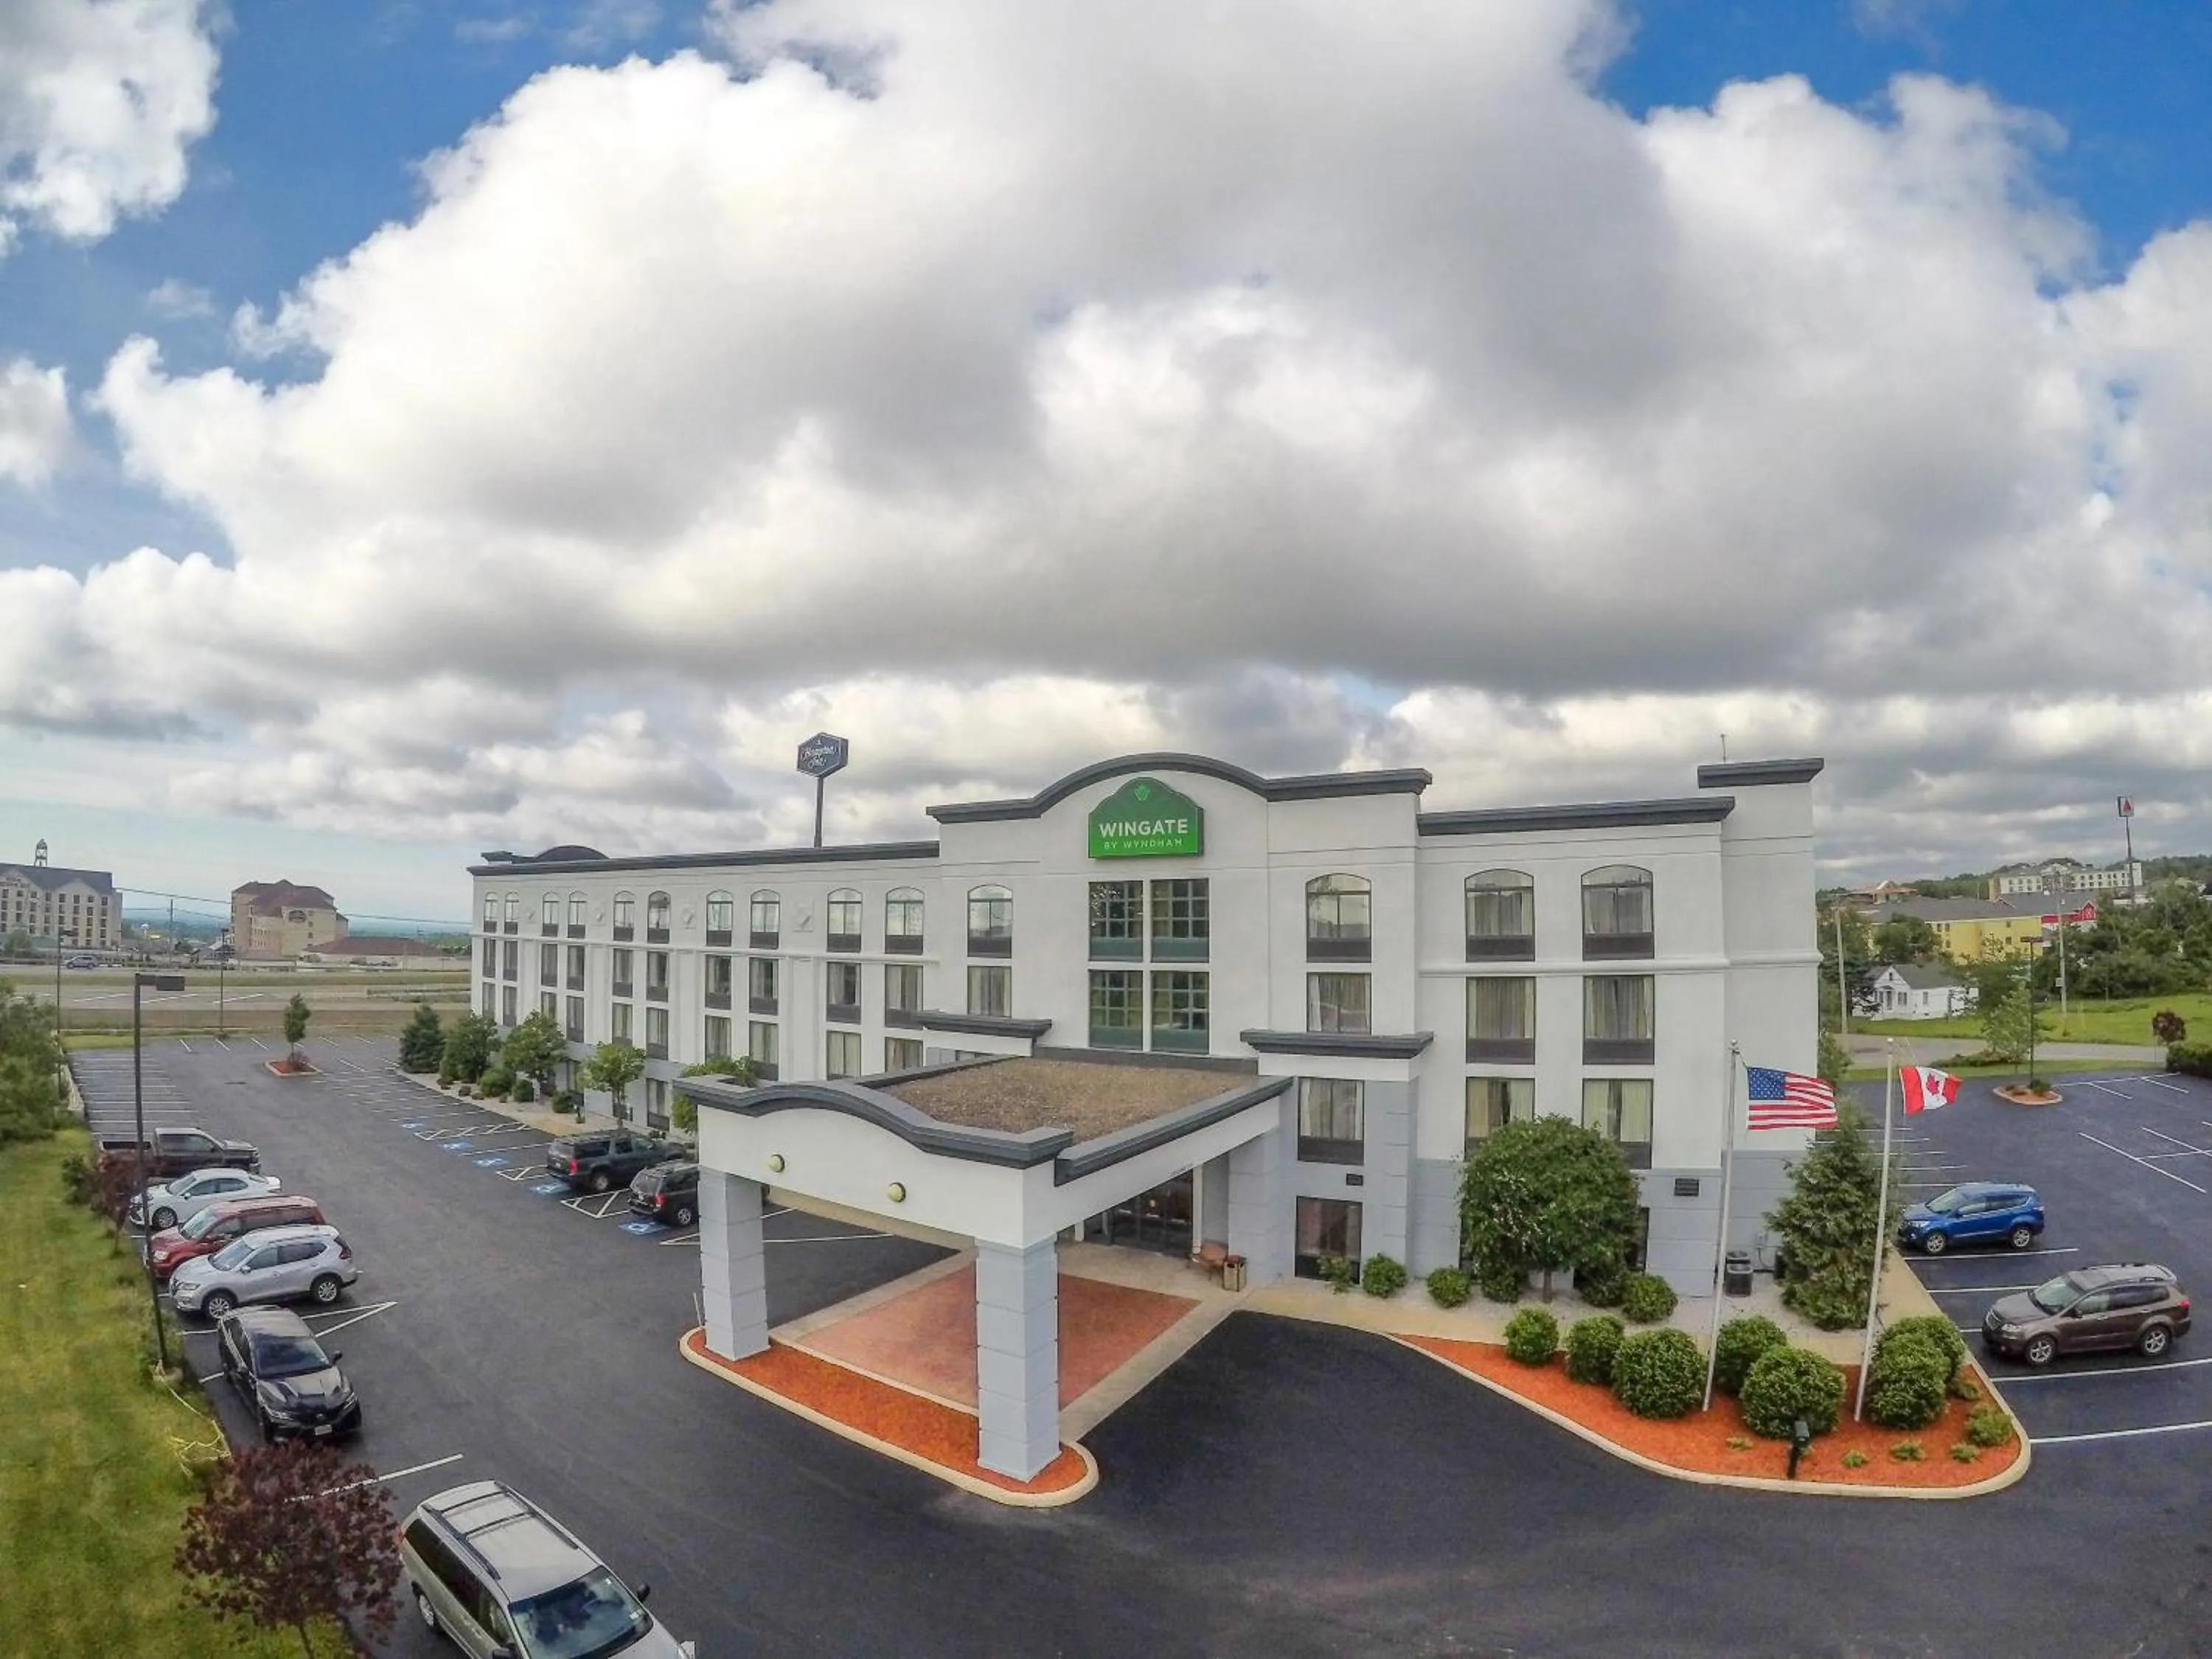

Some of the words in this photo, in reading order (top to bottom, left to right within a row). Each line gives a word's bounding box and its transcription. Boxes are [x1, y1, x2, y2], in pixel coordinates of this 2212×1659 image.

[1099, 818, 1189, 838] WINGATE
[1105, 841, 1118, 849] BY
[1123, 838, 1183, 849] WYNDHAM
